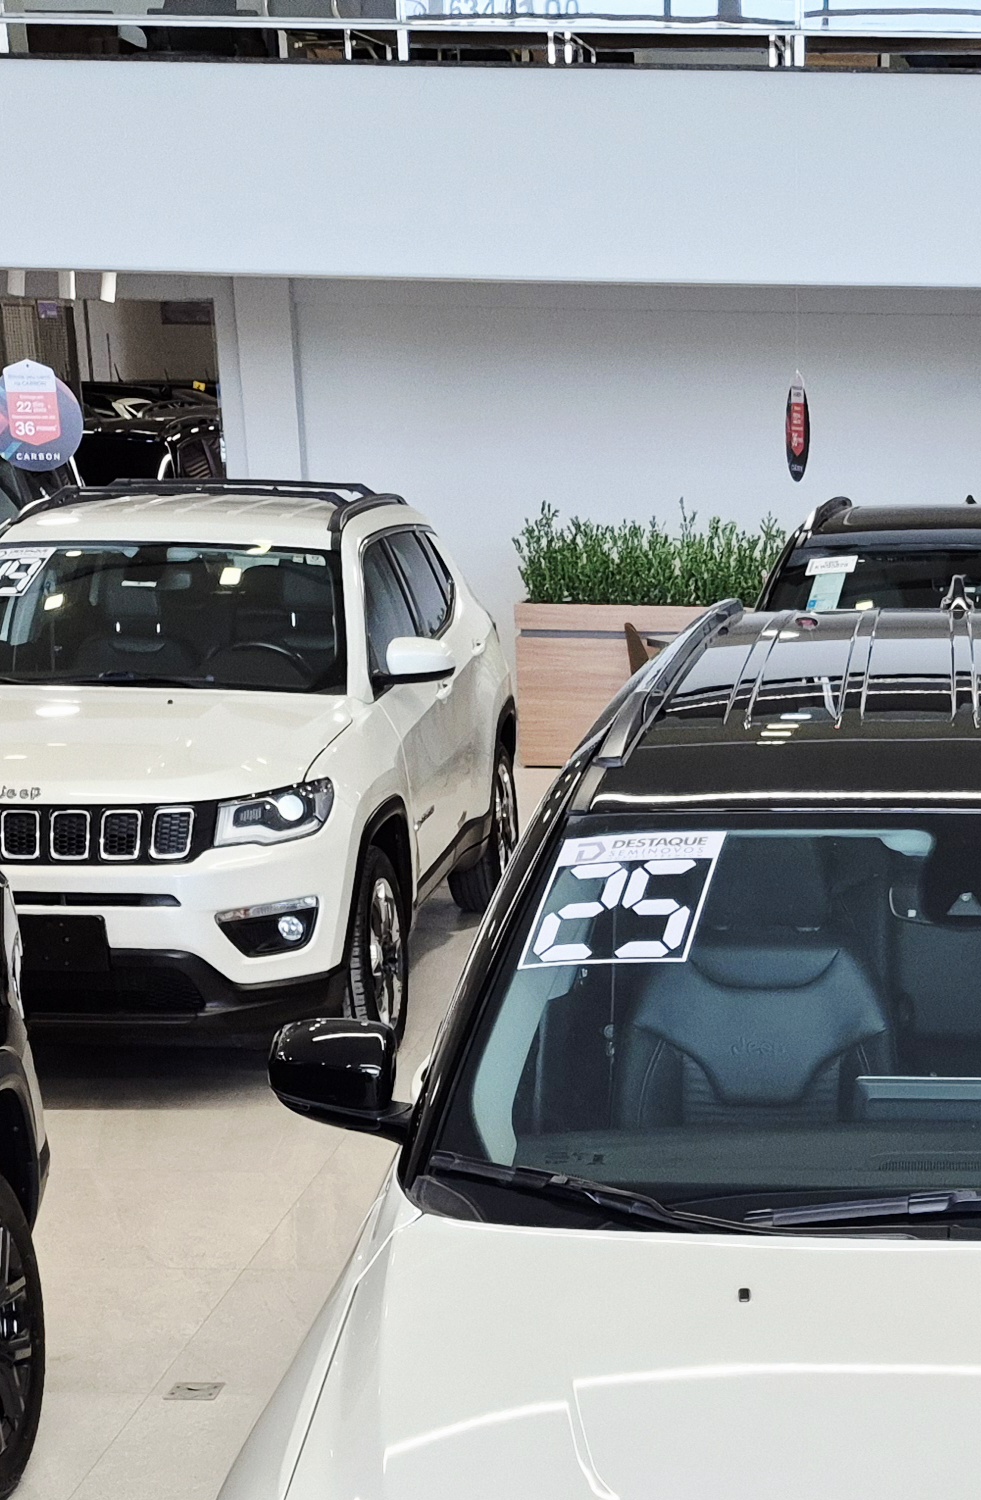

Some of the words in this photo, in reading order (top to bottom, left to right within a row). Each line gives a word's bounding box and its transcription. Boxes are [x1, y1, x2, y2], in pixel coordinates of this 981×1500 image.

[16, 401, 32, 413] 22
[15, 421, 35, 436] 36
[16, 452, 60, 461] CARBON
[612, 836, 709, 850] DESTAQUE
[609, 846, 704, 857] SEMINOVOS
[533, 859, 697, 962] 25
